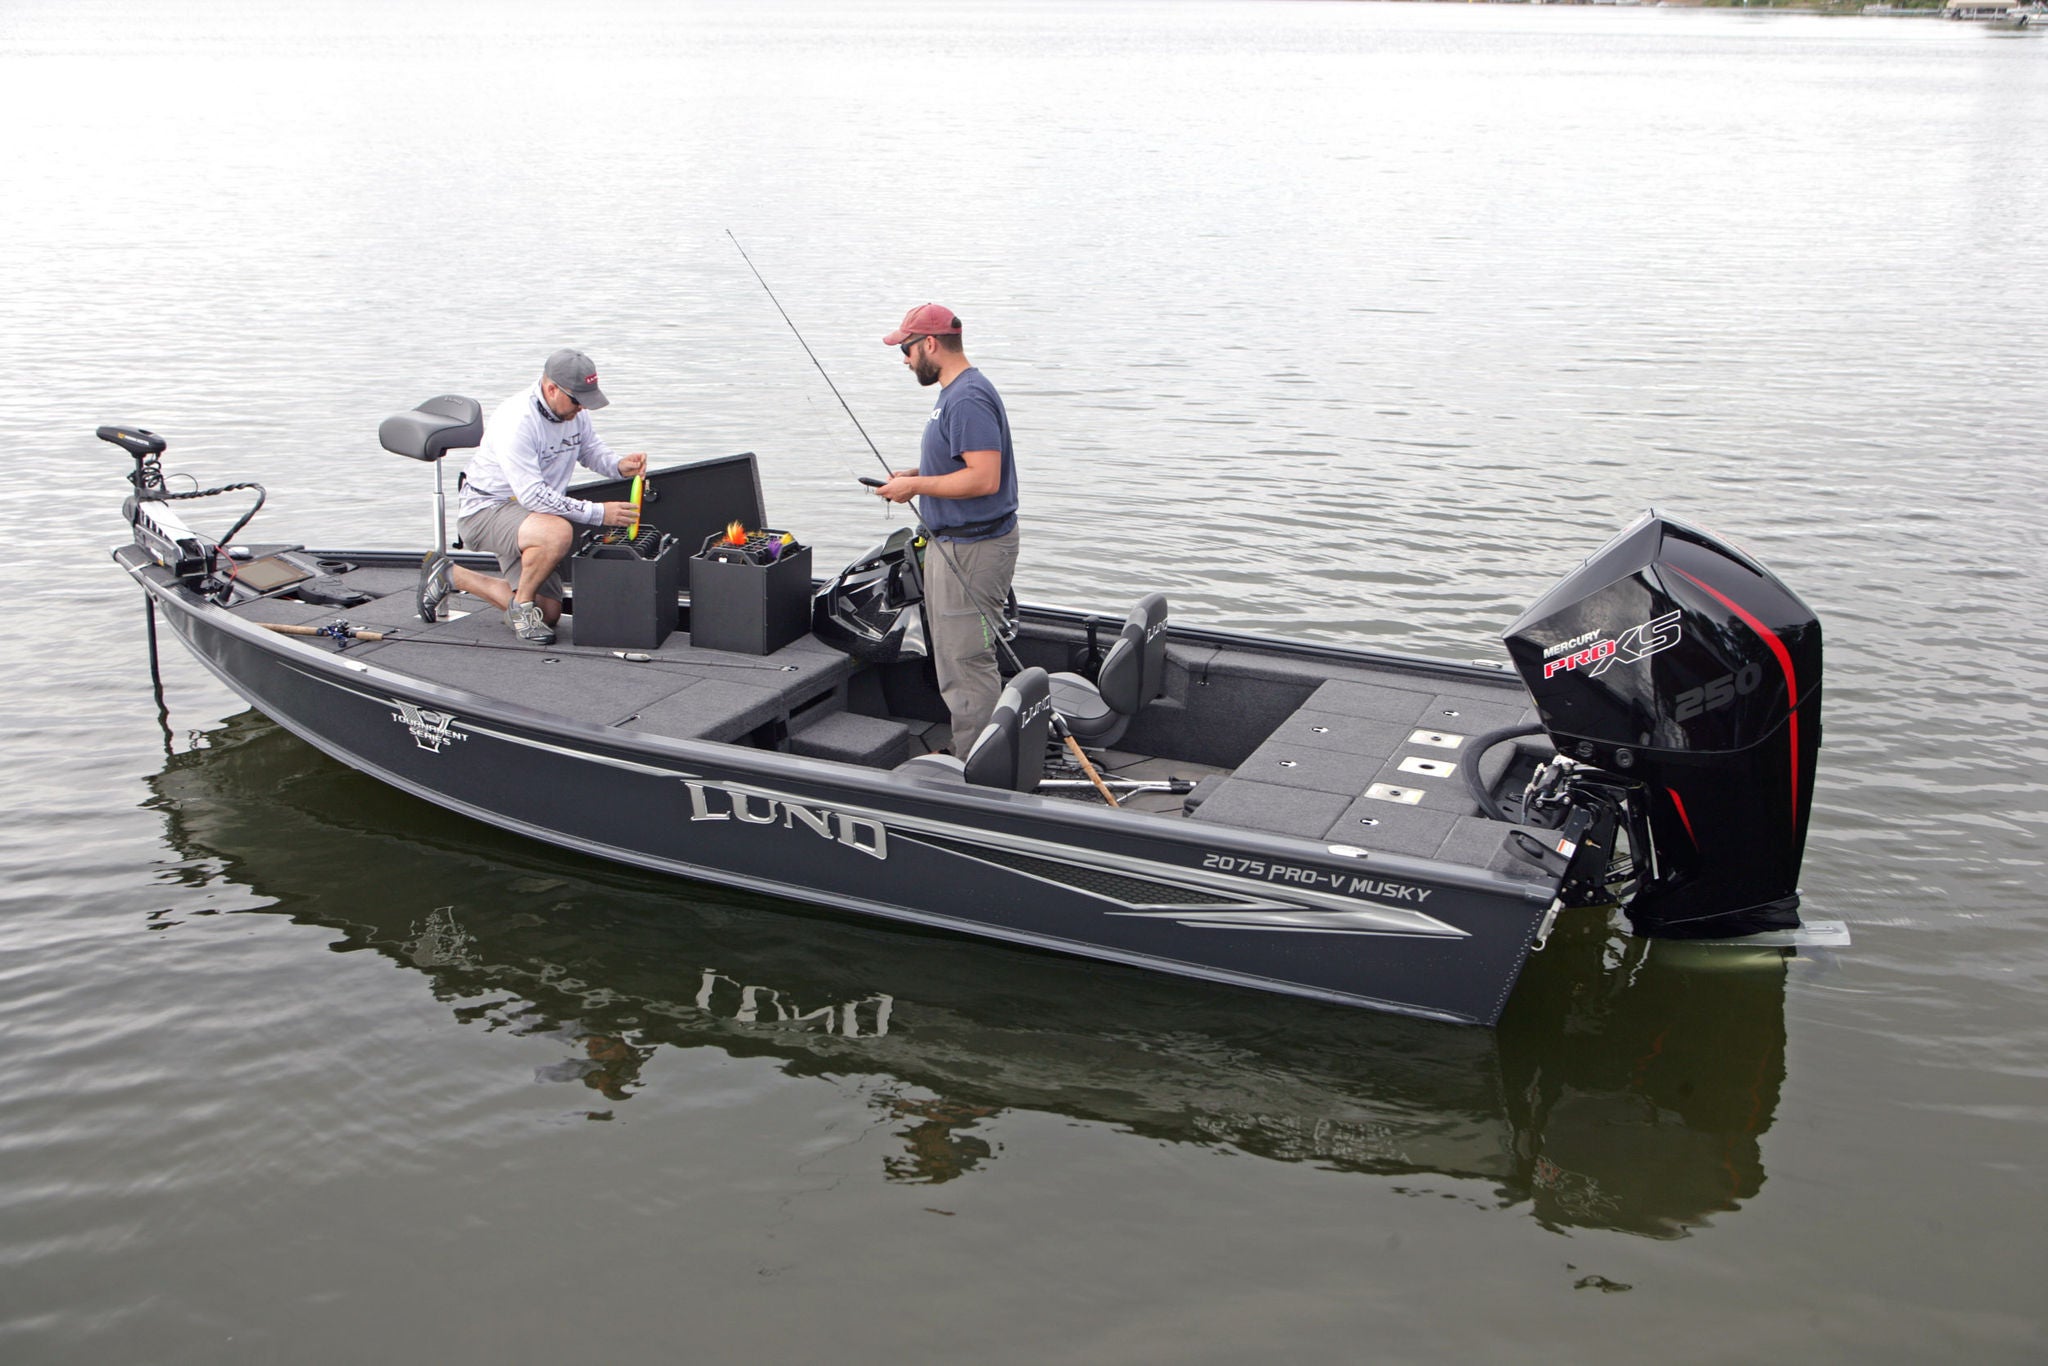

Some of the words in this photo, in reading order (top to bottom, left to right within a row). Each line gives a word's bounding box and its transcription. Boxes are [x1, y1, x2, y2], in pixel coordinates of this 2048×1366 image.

[1543, 628, 1601, 660] MERCURY
[1543, 639, 1617, 680] PRO
[1674, 661, 1763, 723] 250
[390, 712, 469, 742] TOURNAMENT
[408, 727, 452, 746] SERIES
[684, 782, 888, 860] LUND
[1202, 853, 1266, 876] 2075
[1267, 863, 1346, 889] PRO-V
[1349, 877, 1433, 903] MUSKY
